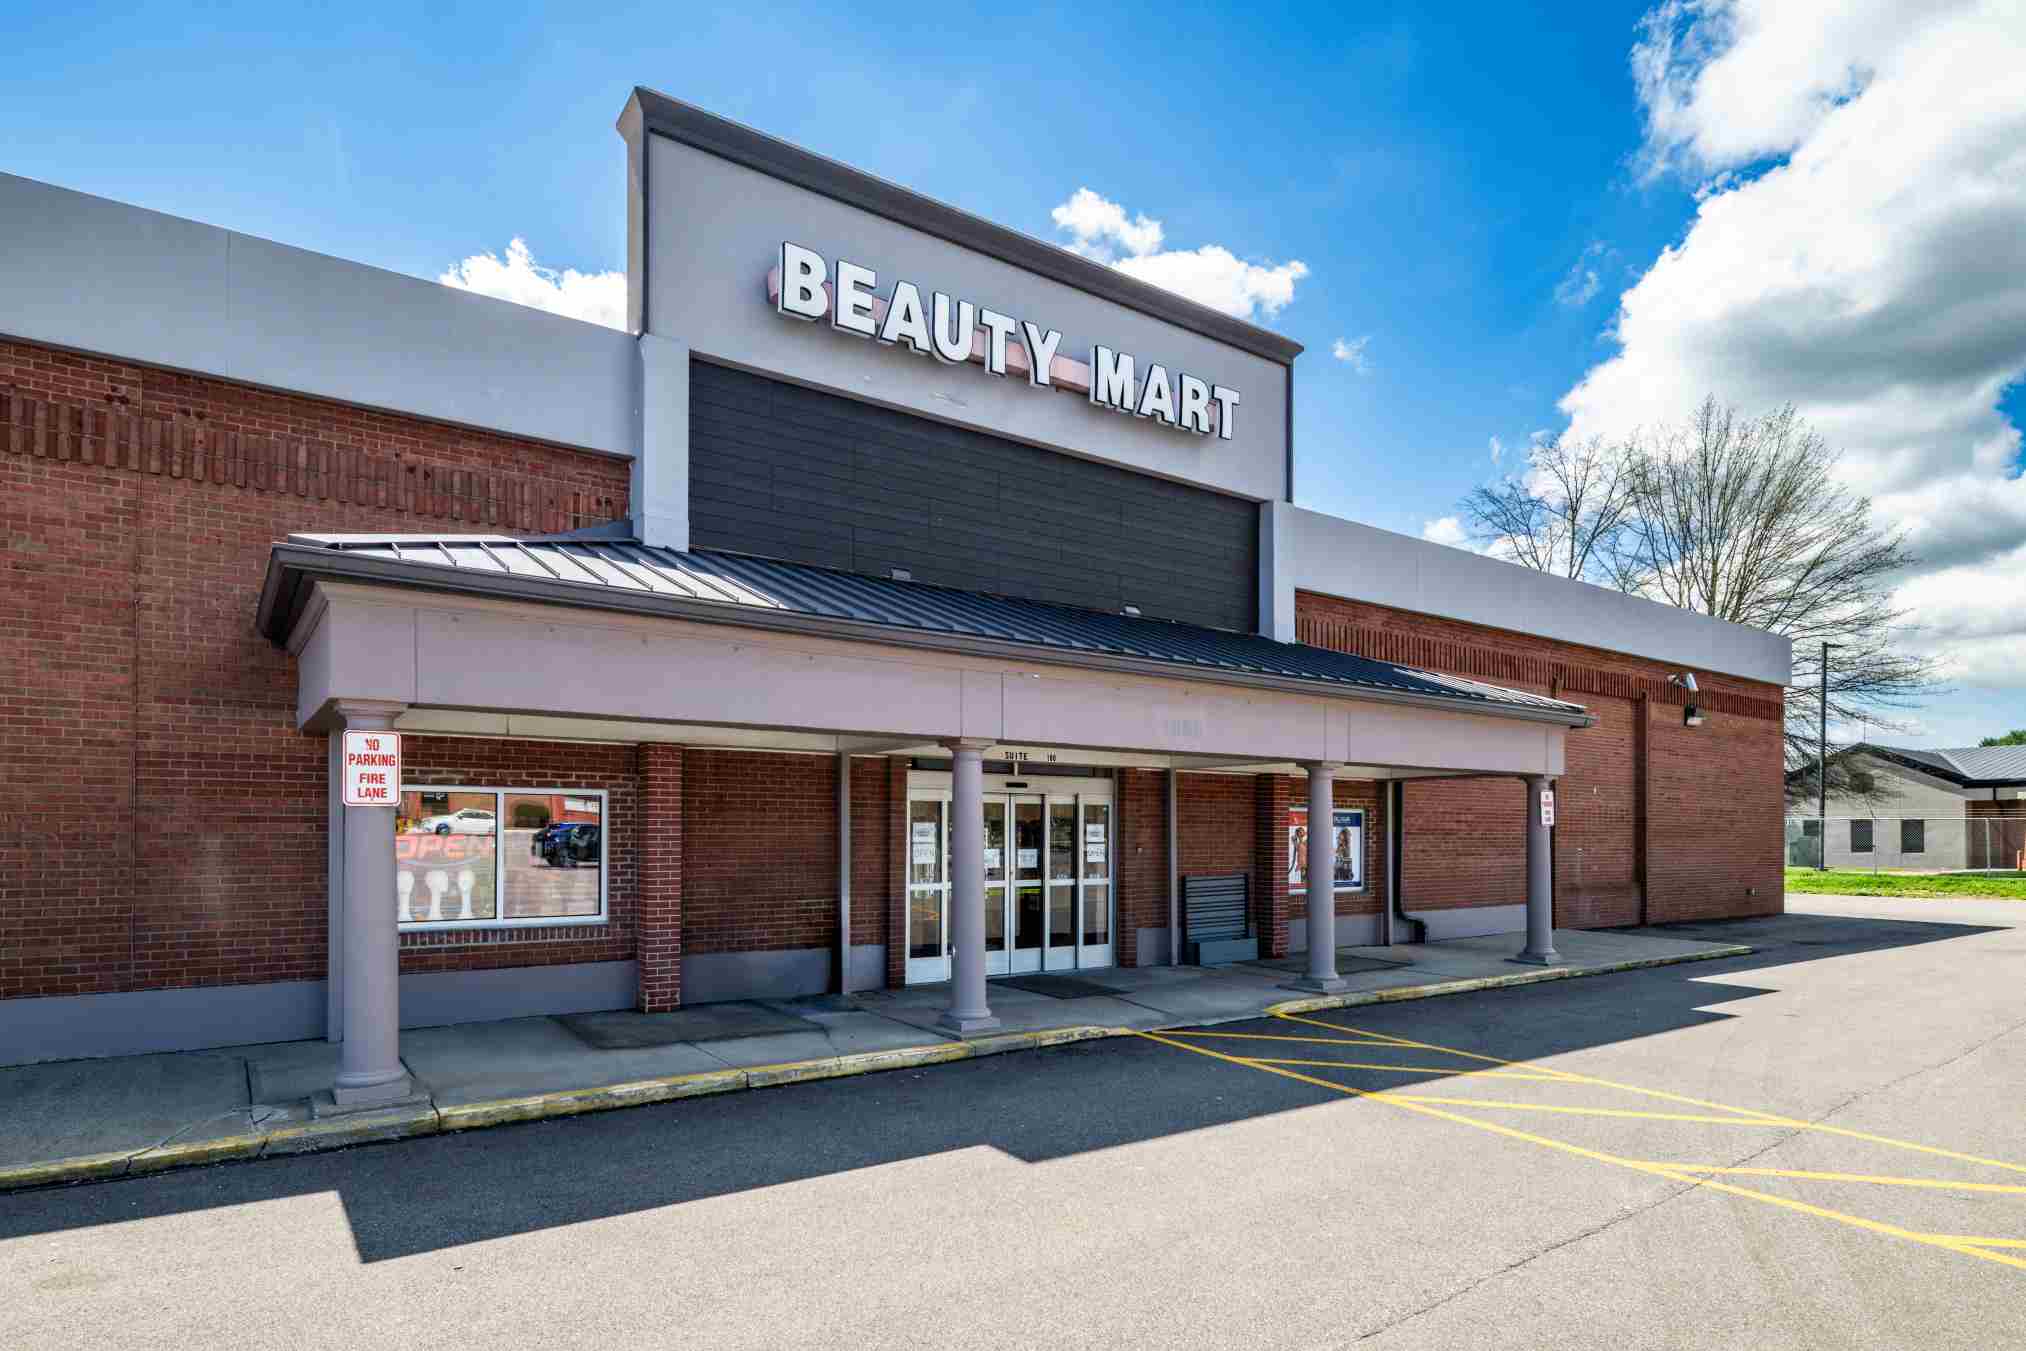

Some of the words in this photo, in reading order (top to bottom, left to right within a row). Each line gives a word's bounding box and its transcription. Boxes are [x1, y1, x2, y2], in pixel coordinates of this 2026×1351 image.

[779, 241, 1063, 386] BEAUTY
[1091, 345, 1240, 440] MART
[365, 738, 380, 751] NO
[347, 753, 396, 767] PARKING
[1004, 751, 1030, 761] SUITE
[359, 773, 386, 785] FIRE
[358, 787, 388, 799] LANE
